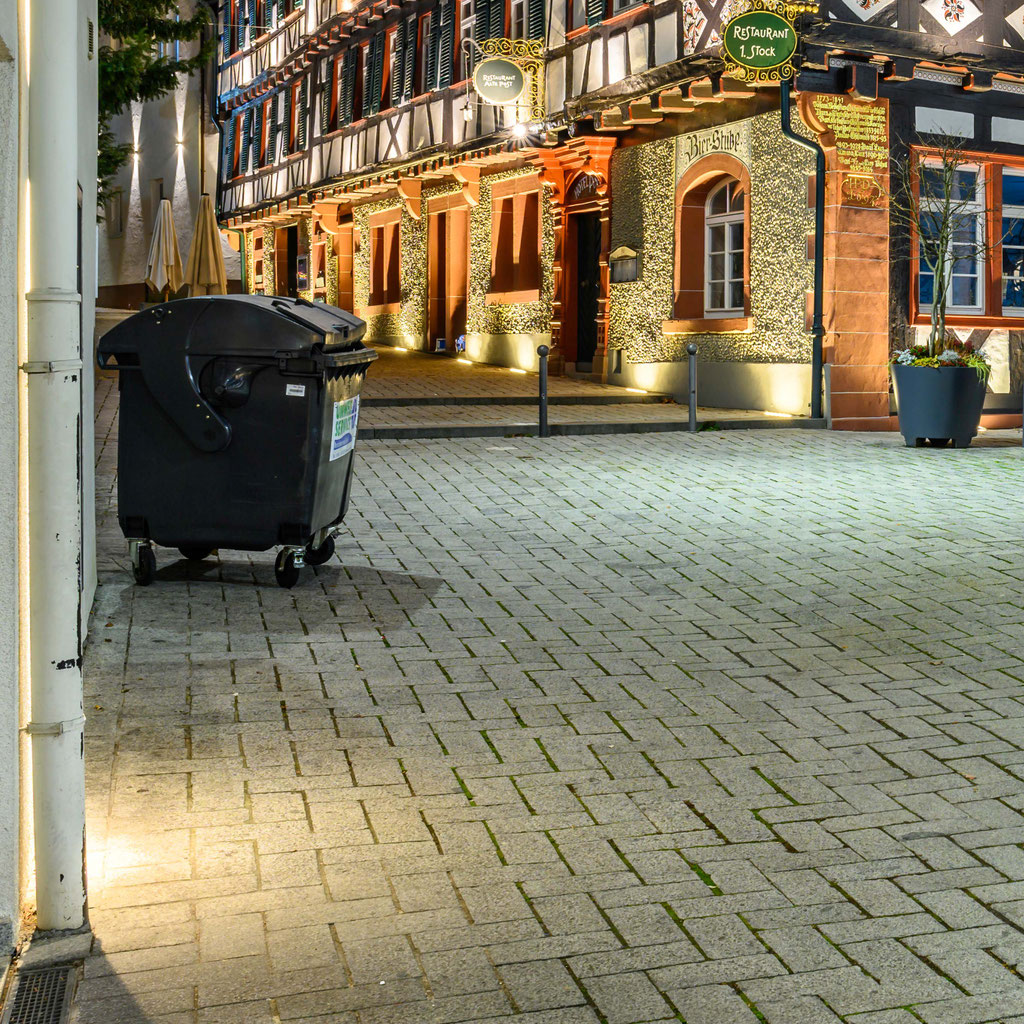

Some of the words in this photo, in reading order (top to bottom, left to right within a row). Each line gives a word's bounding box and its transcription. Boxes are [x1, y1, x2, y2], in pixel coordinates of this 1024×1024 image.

[733, 26, 789, 40] RESTAURANT
[739, 44, 747, 58] 1.
[746, 44, 776, 60] STOCK
